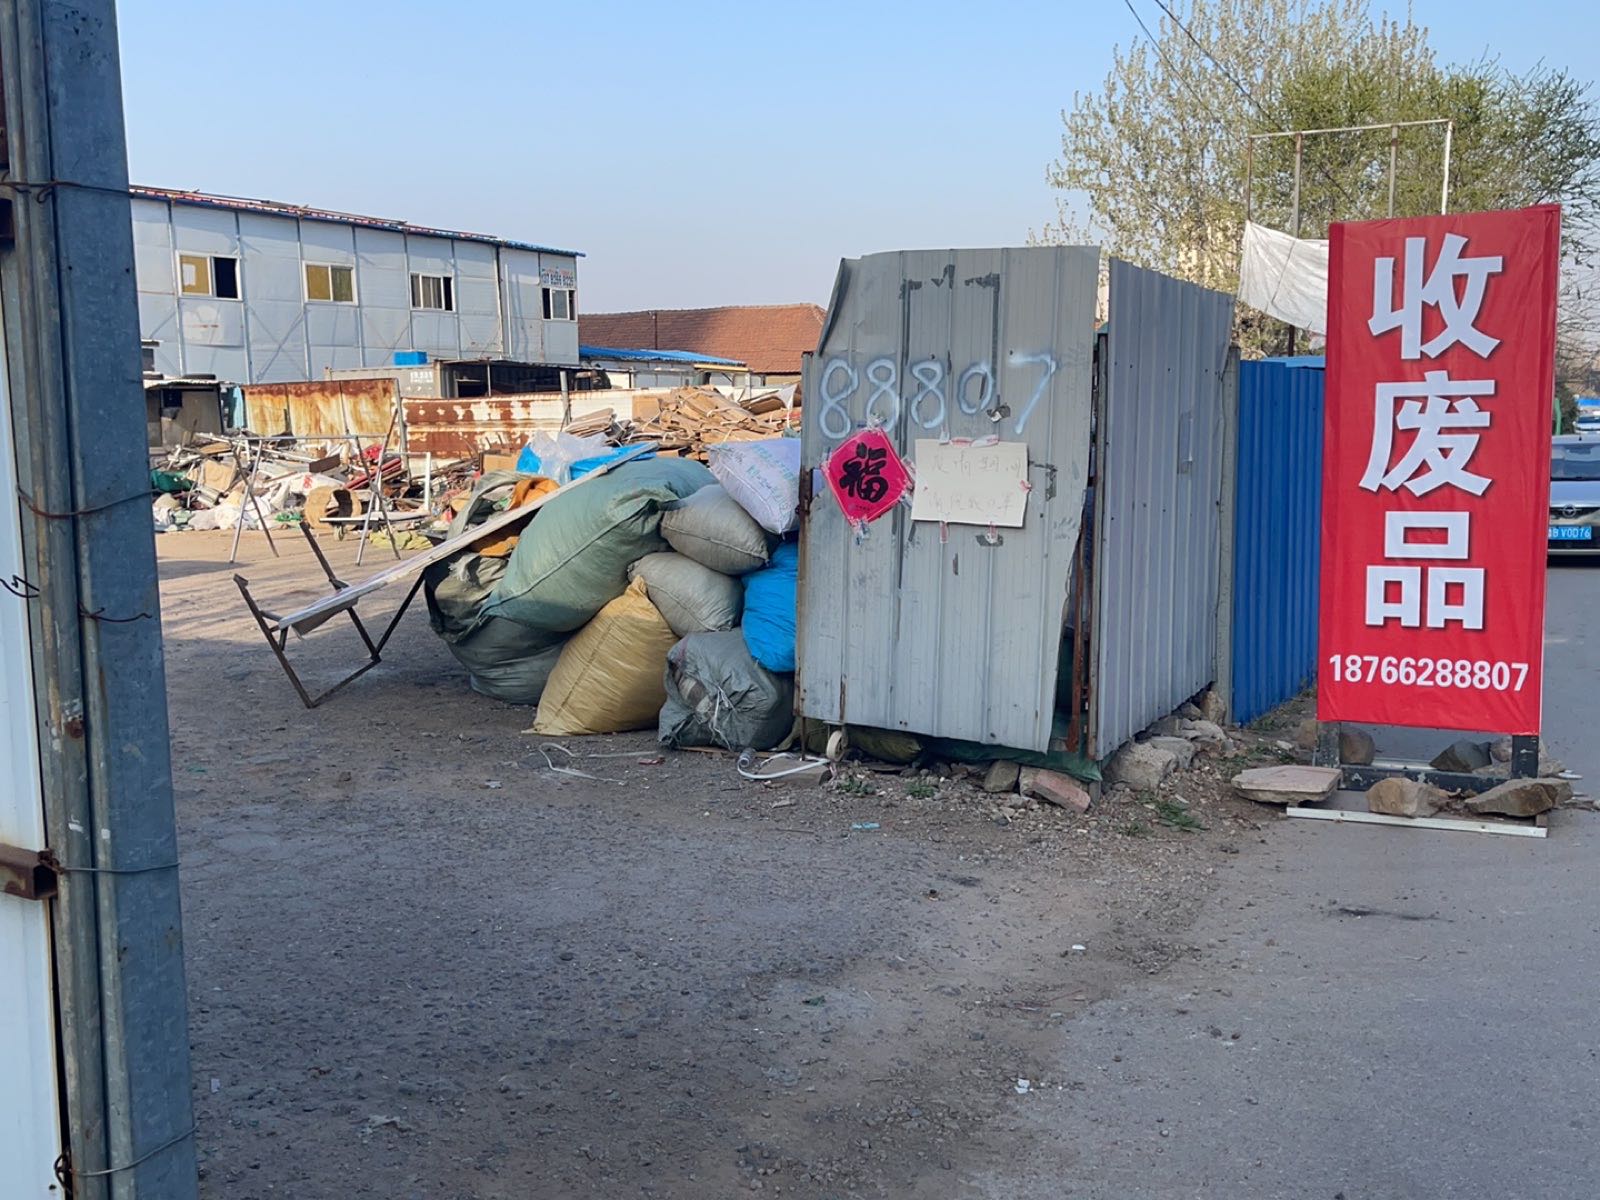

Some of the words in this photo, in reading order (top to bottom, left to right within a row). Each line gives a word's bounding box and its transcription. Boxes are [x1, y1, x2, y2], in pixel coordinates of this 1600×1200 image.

[819, 355, 1057, 439] 88807
[1359, 233, 1502, 630] 收废品
[840, 443, 889, 503] 福
[1329, 655, 1529, 691] 18766288807
